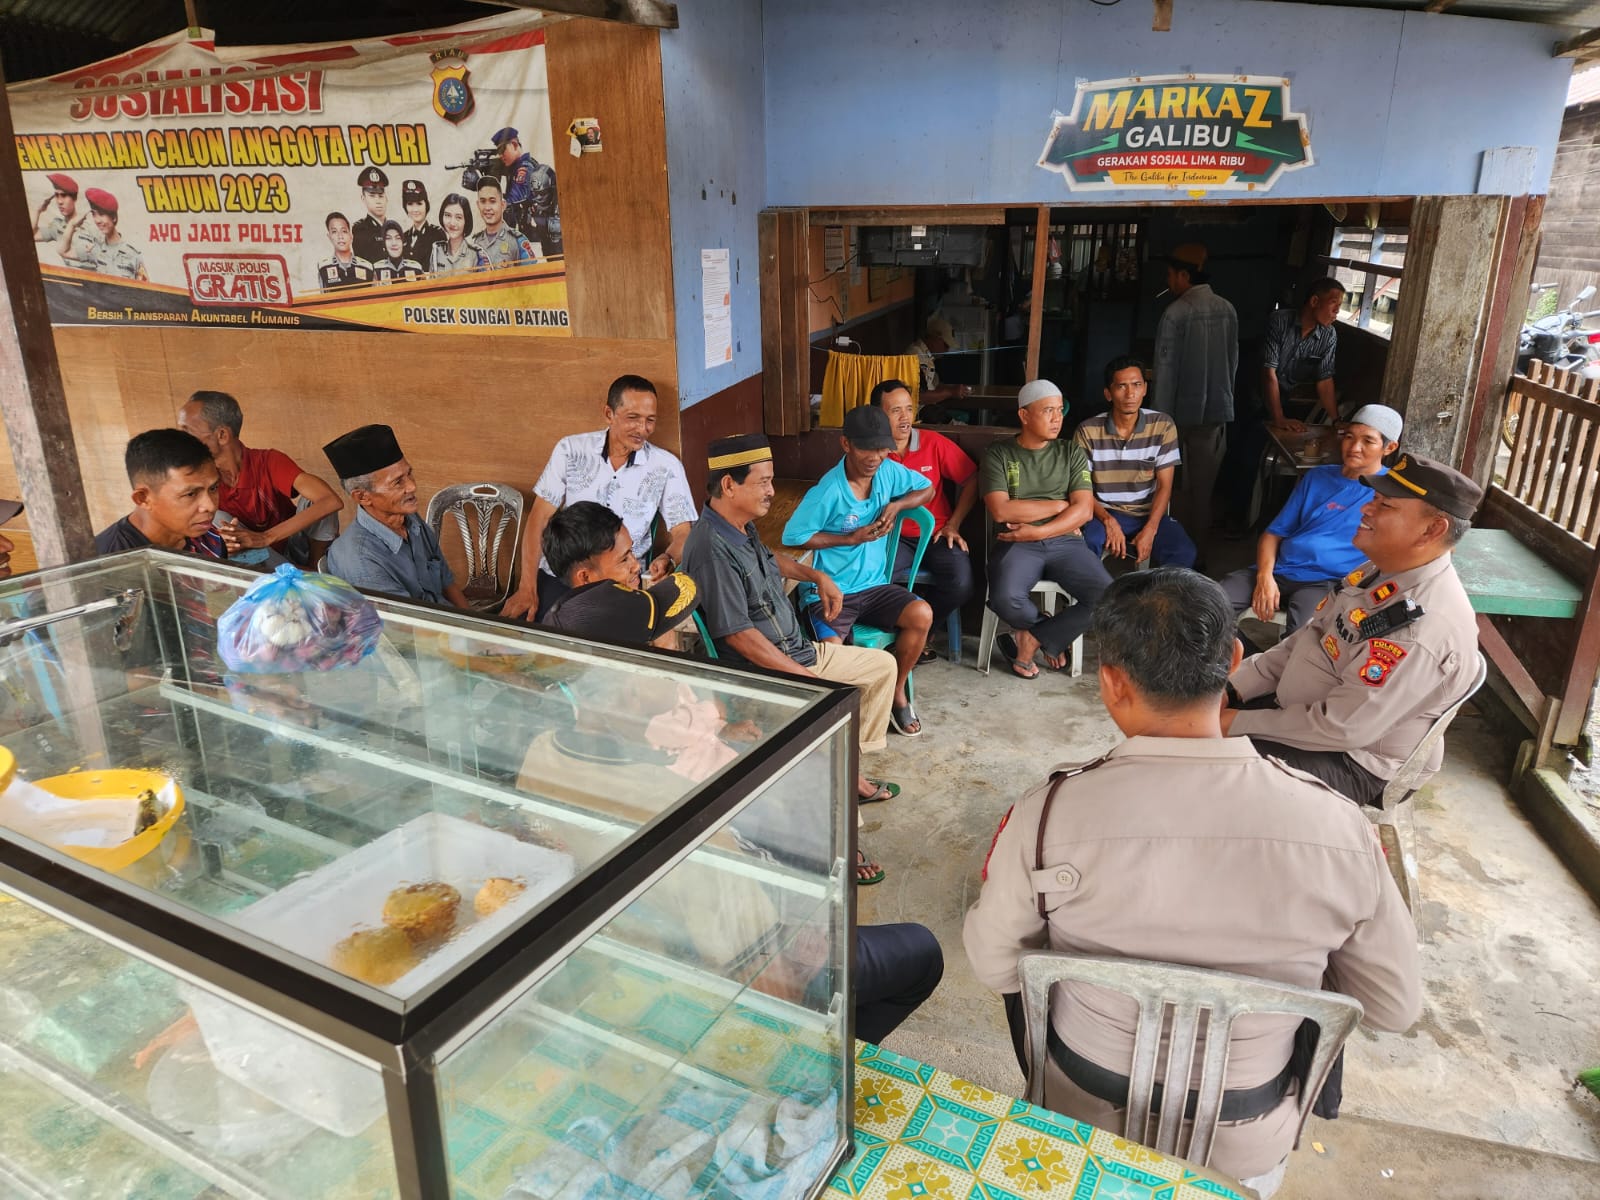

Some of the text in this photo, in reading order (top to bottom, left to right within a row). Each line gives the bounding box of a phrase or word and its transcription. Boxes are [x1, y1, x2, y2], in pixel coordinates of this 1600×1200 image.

[435, 48, 464, 60] RIAU
[70, 65, 324, 121] SOSIALISASI
[1082, 85, 1273, 132] MARKAZ
[14, 123, 431, 171] ENERIMAAN CALON ANGGOTA POLRI
[1125, 124, 1232, 149] GALIBU
[1097, 154, 1246, 167] GERAKAN SOSIAL LIMA RIBU
[1123, 171, 1138, 181] The
[1167, 171, 1179, 183] for
[1182, 171, 1218, 182] Indonesia
[136, 173, 291, 213] TAHUN 2023
[149, 223, 304, 244] AYO JADI POLISI
[198, 261, 271, 274] MASUK POLISI
[194, 274, 283, 301] GRATIS
[87, 306, 301, 326] BERSIH TRANSPARAN AKUNTABEL HUMANIS
[404, 307, 569, 327] POLSEK SUNGAI BATANG
